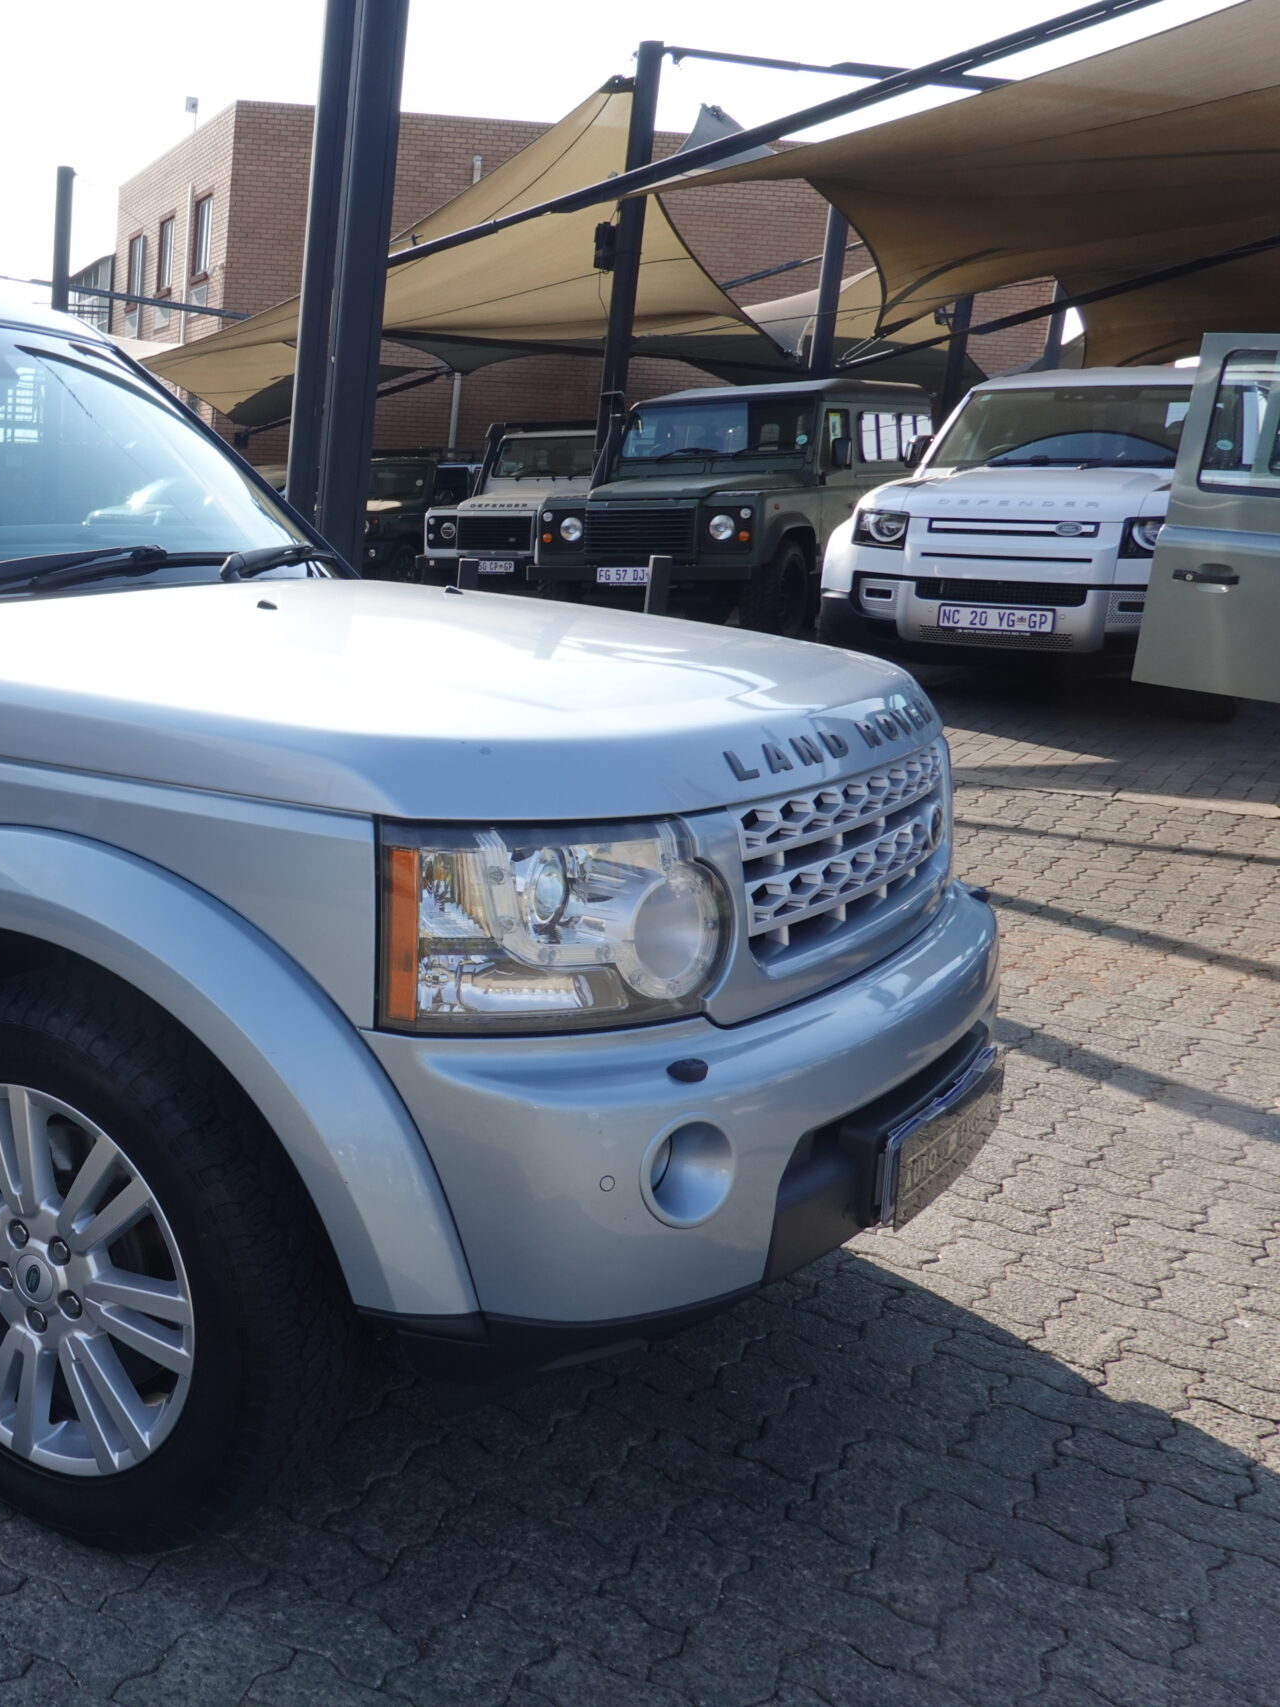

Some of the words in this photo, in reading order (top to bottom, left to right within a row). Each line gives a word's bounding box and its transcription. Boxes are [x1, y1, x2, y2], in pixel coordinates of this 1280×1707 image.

[937, 499, 1100, 509] DEFENDER
[504, 562, 512, 571] GP
[599, 569, 610, 581] FG
[615, 569, 627, 581] 57
[632, 569, 645, 581] DJ
[942, 609, 960, 625] NC
[969, 610, 988, 626] 20
[998, 612, 1016, 628] YG
[1028, 613, 1048, 630] GP
[722, 729, 850, 782] LAND
[854, 699, 933, 749] ROVER
